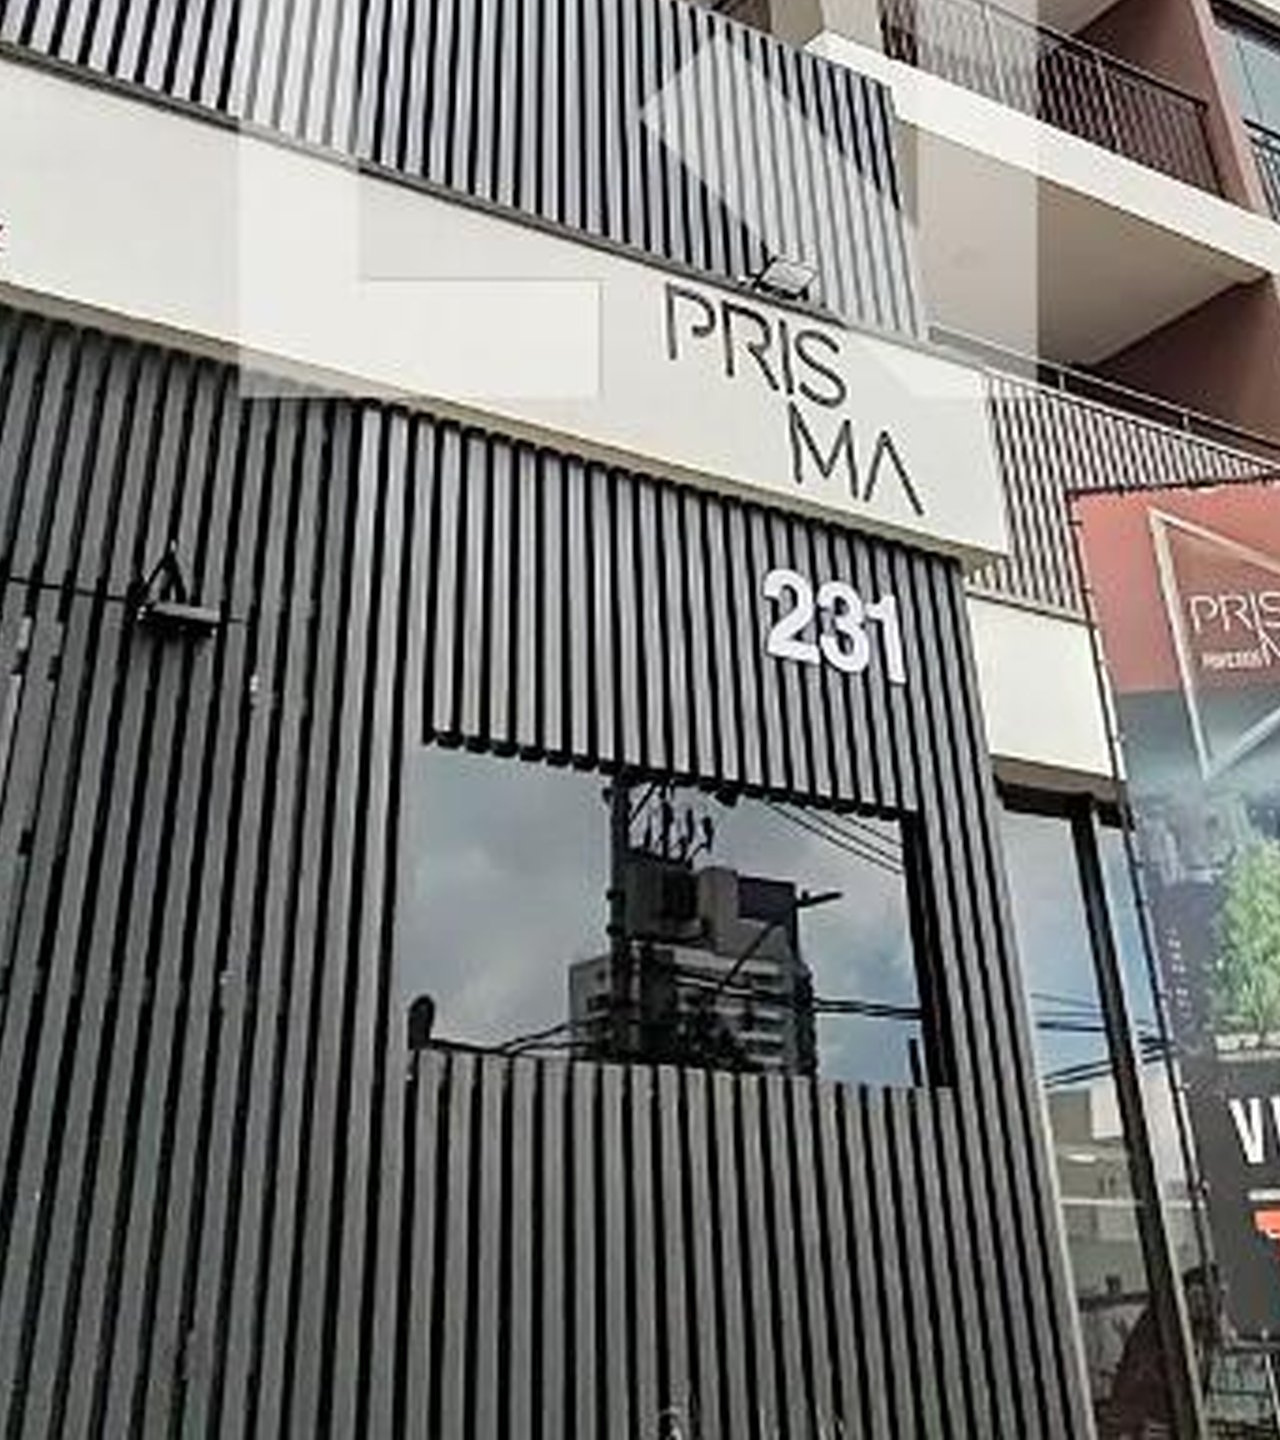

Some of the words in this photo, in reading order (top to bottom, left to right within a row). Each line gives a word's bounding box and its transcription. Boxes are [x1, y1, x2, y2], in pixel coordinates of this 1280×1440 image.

[665, 281, 848, 408] PRIS
[788, 400, 925, 517] MA
[762, 568, 907, 686] 231
